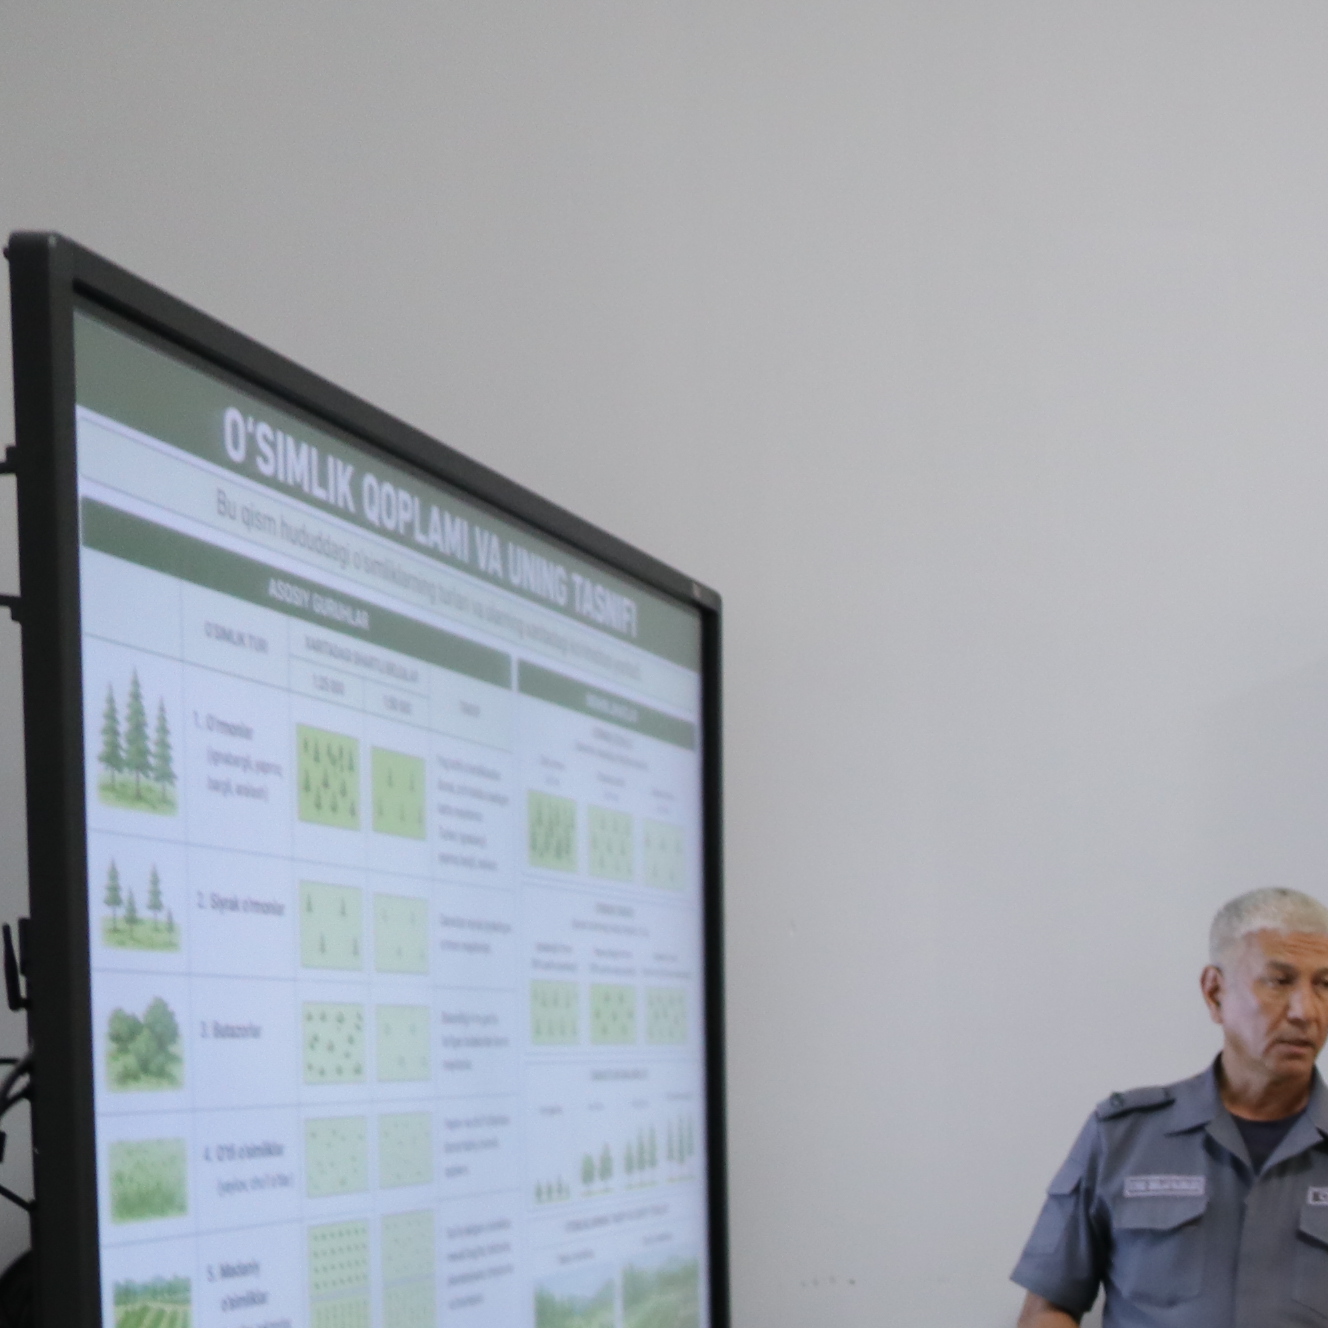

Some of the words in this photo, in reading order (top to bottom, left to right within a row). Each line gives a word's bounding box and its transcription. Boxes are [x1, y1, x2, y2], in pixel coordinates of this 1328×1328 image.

[216, 487, 237, 520] Bu
[241, 503, 276, 532] qism
[362, 472, 469, 564] QOPLAMI
[475, 525, 503, 578] VA
[507, 541, 568, 606] UNING
